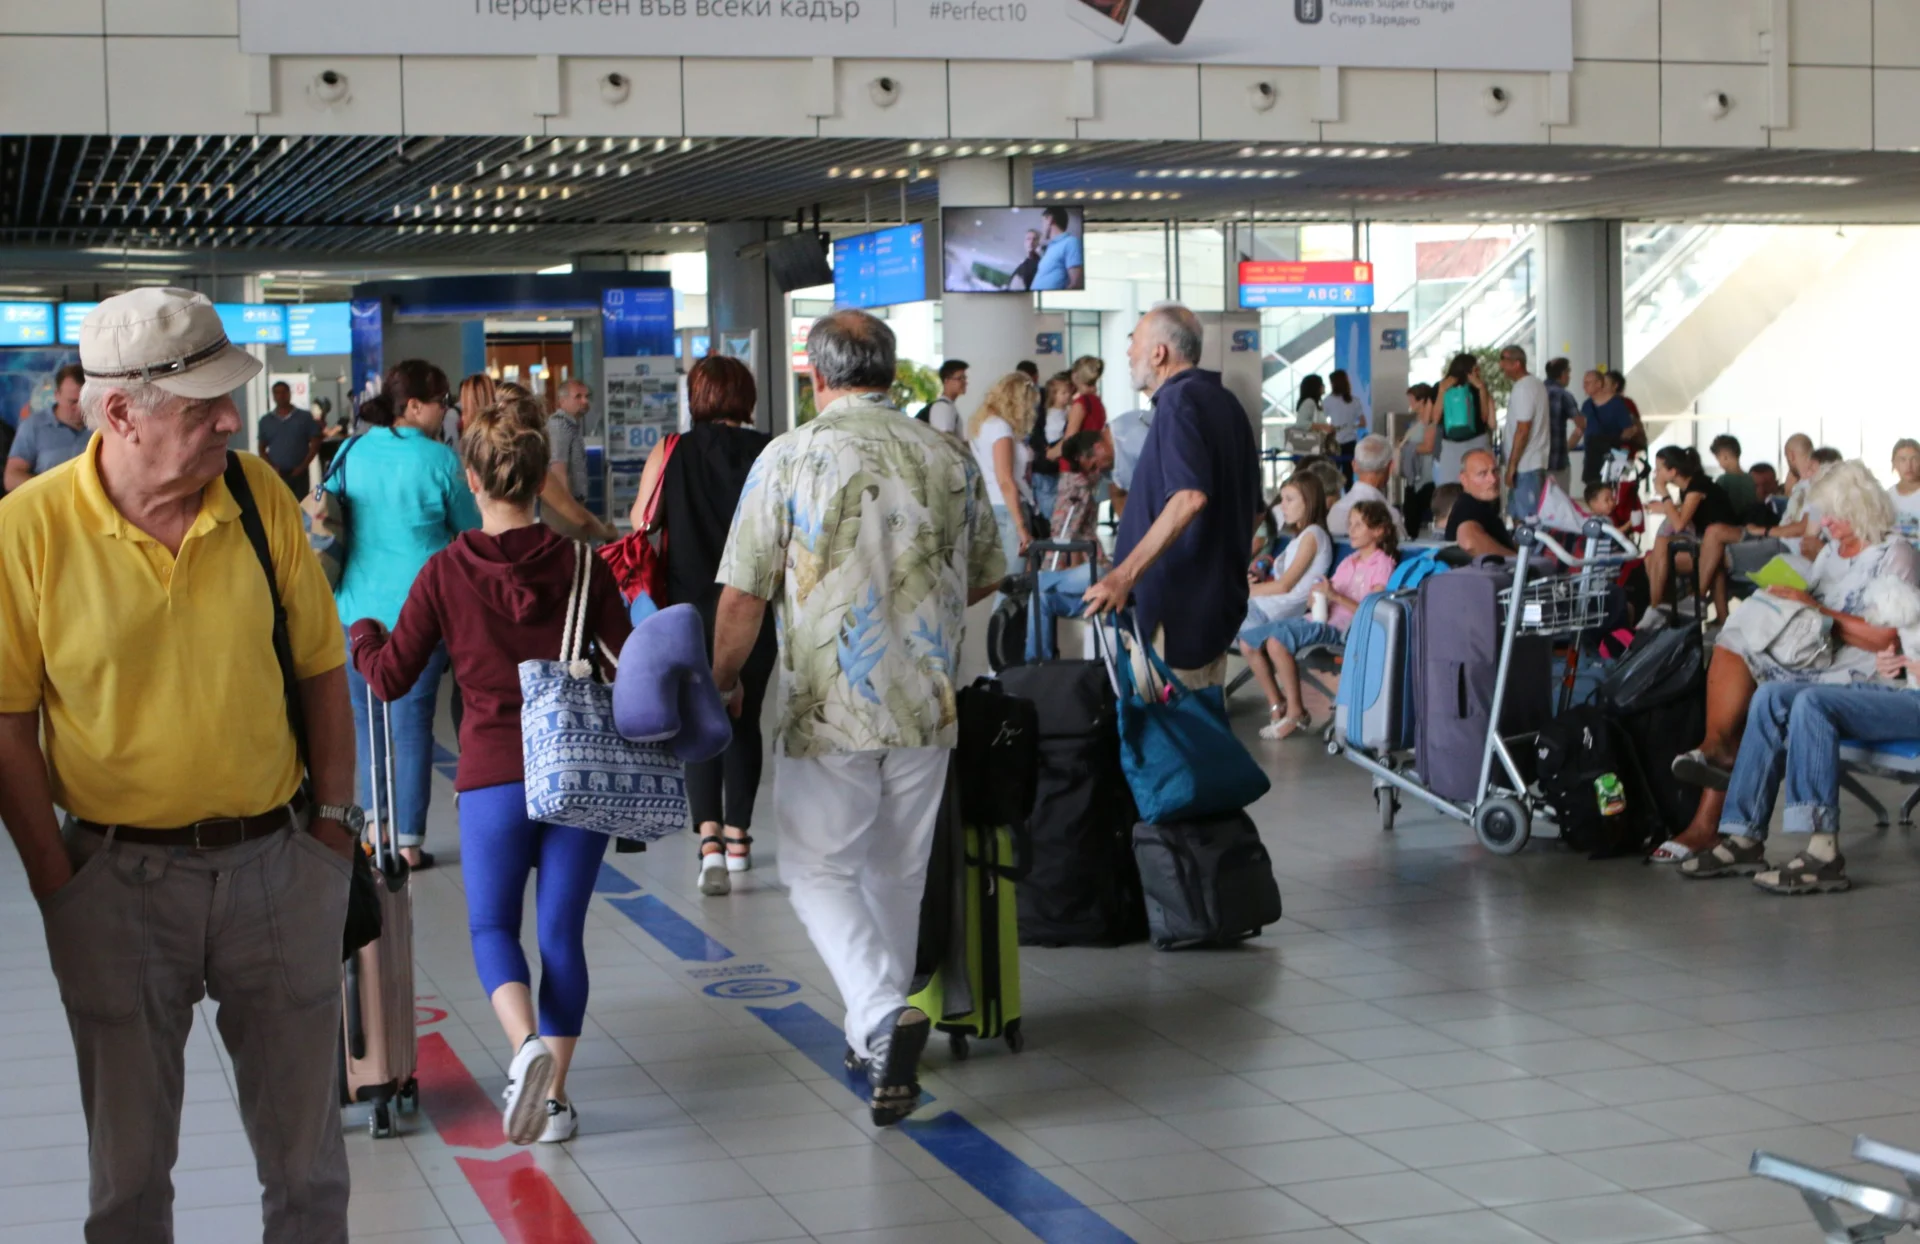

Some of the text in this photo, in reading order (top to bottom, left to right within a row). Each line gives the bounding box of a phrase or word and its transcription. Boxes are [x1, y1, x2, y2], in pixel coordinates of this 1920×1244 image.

[640, 0, 687, 17] във
[696, 0, 771, 18] всеки
[781, 0, 860, 24] кадър
[929, 0, 1027, 22] #Perfect10
[1377, 0, 1410, 12] Super
[1413, 0, 1455, 13] Charge
[1329, 12, 1366, 27] Супер
[629, 427, 658, 448] 80
